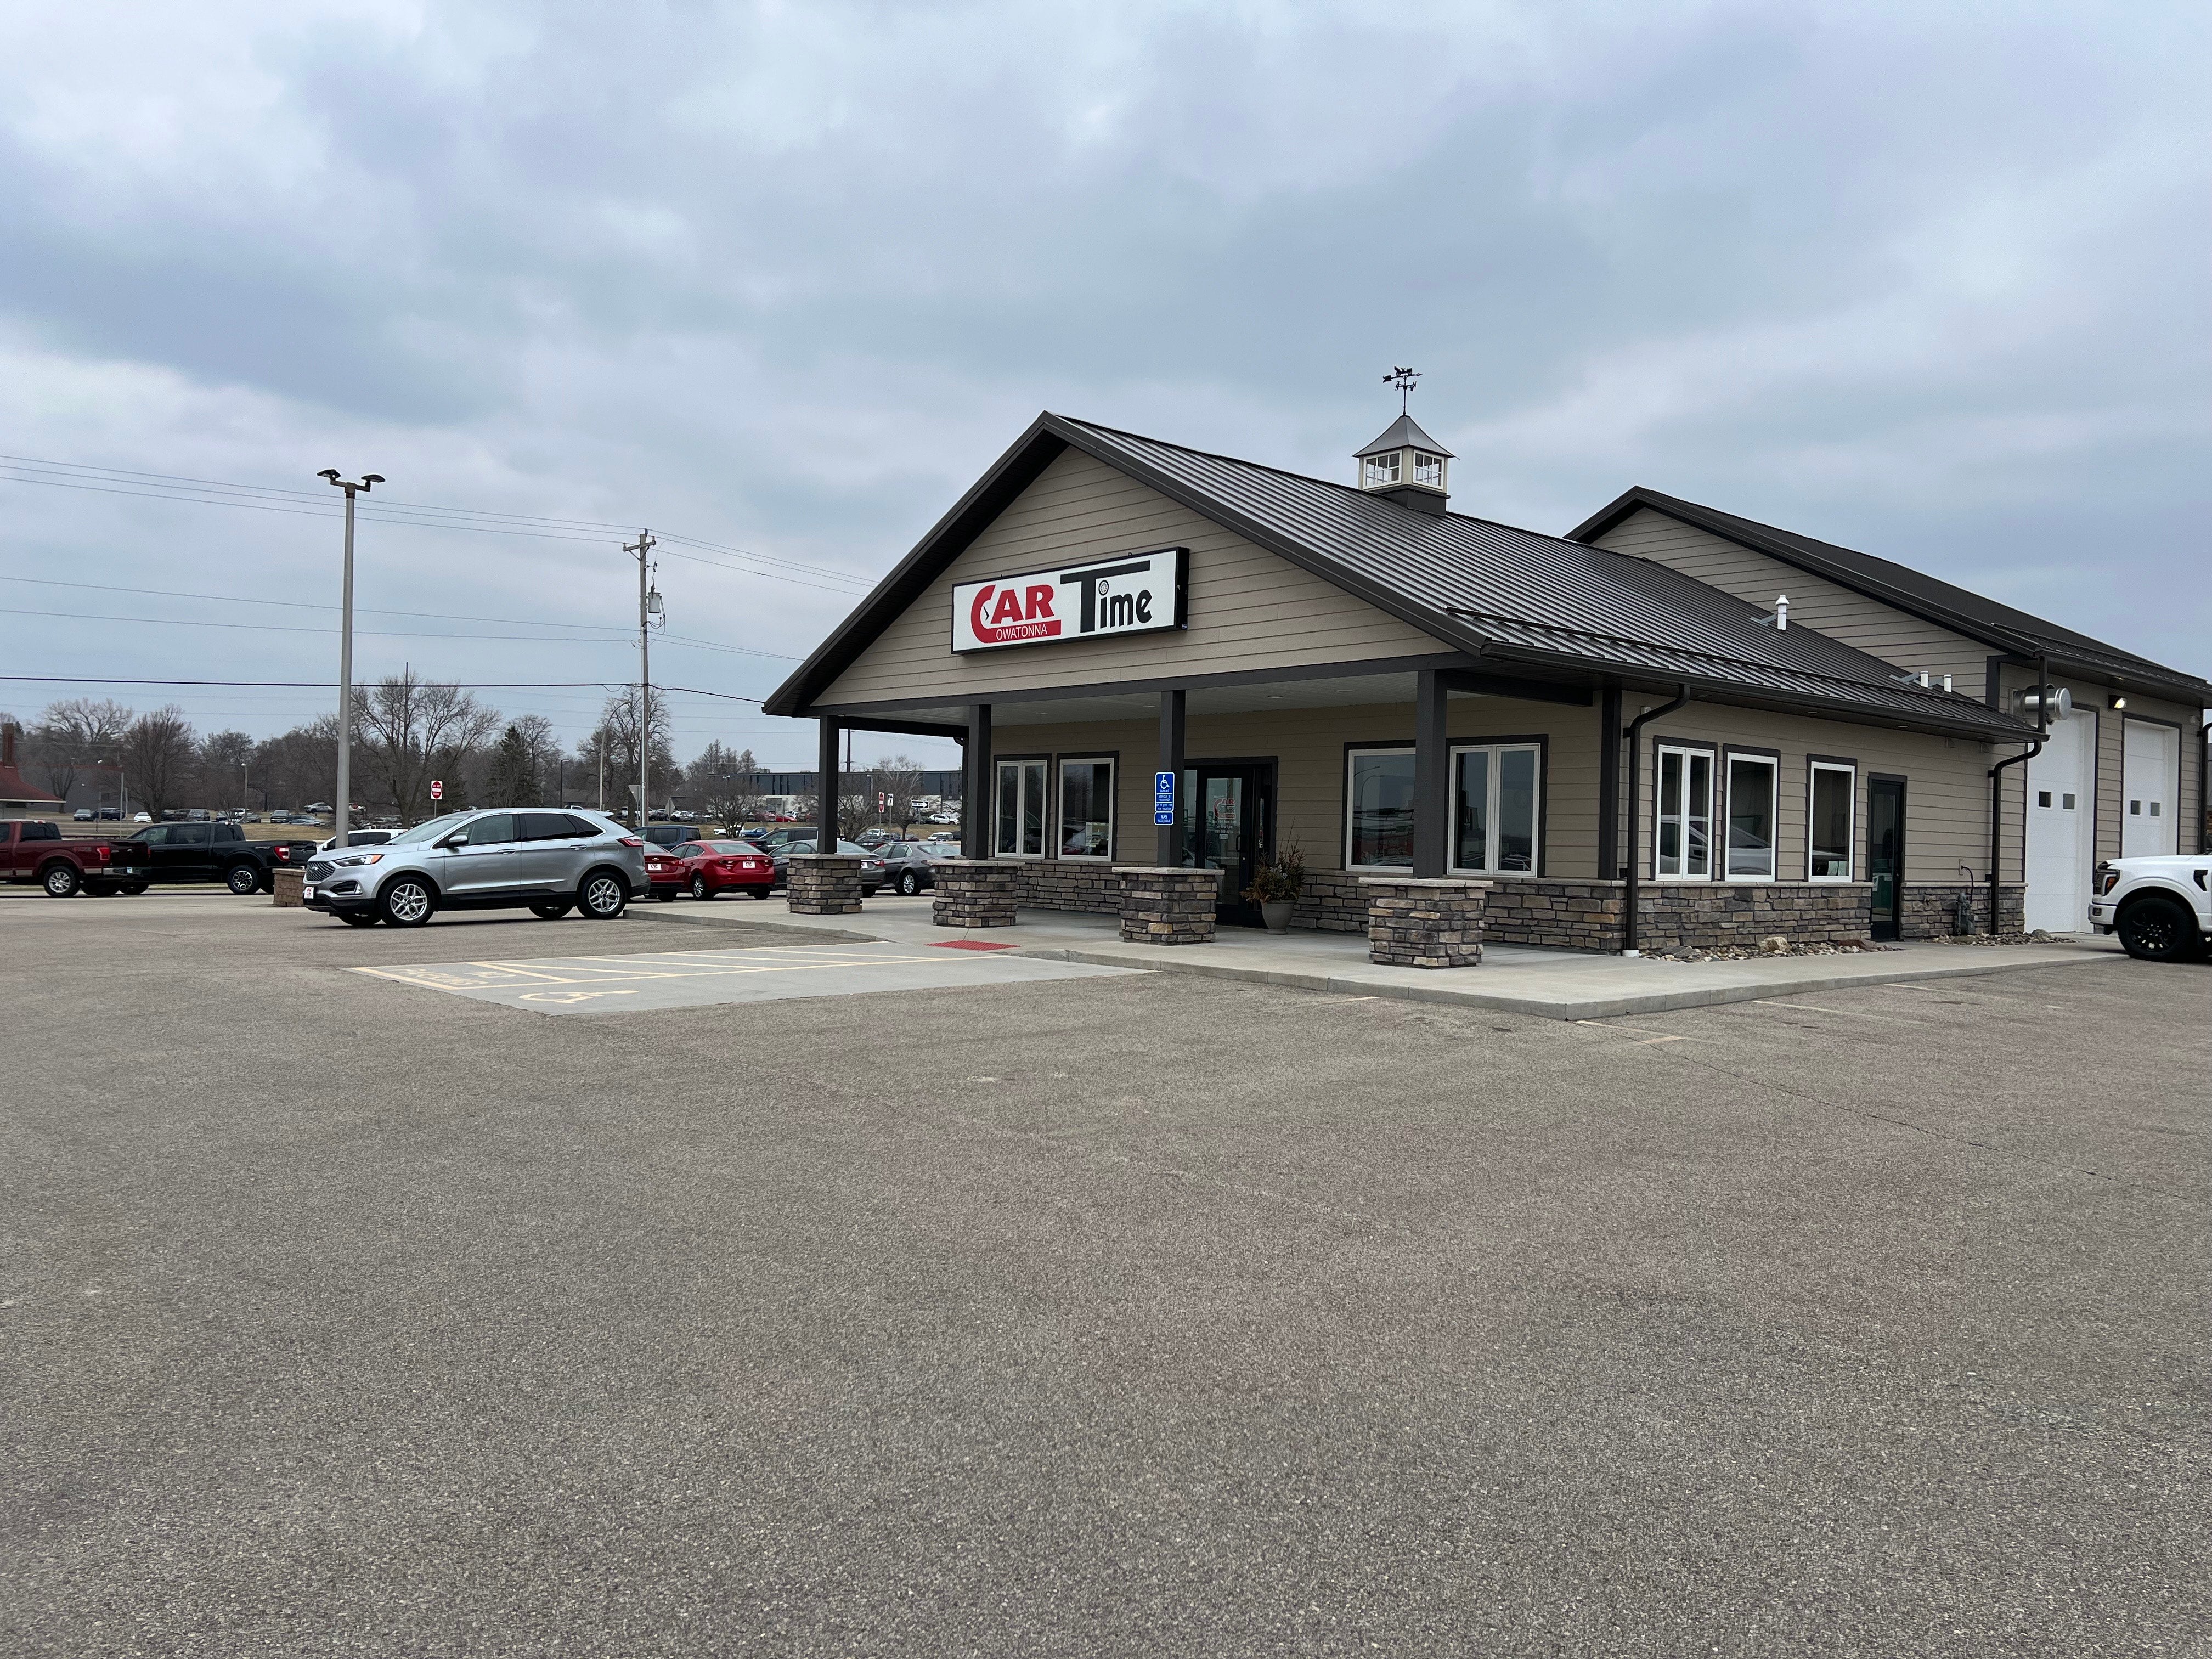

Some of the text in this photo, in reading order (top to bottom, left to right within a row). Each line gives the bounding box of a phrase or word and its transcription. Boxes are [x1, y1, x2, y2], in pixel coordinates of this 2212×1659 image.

[971, 560, 1152, 643] CAR Time
[996, 624, 1048, 640] OWATONNA
